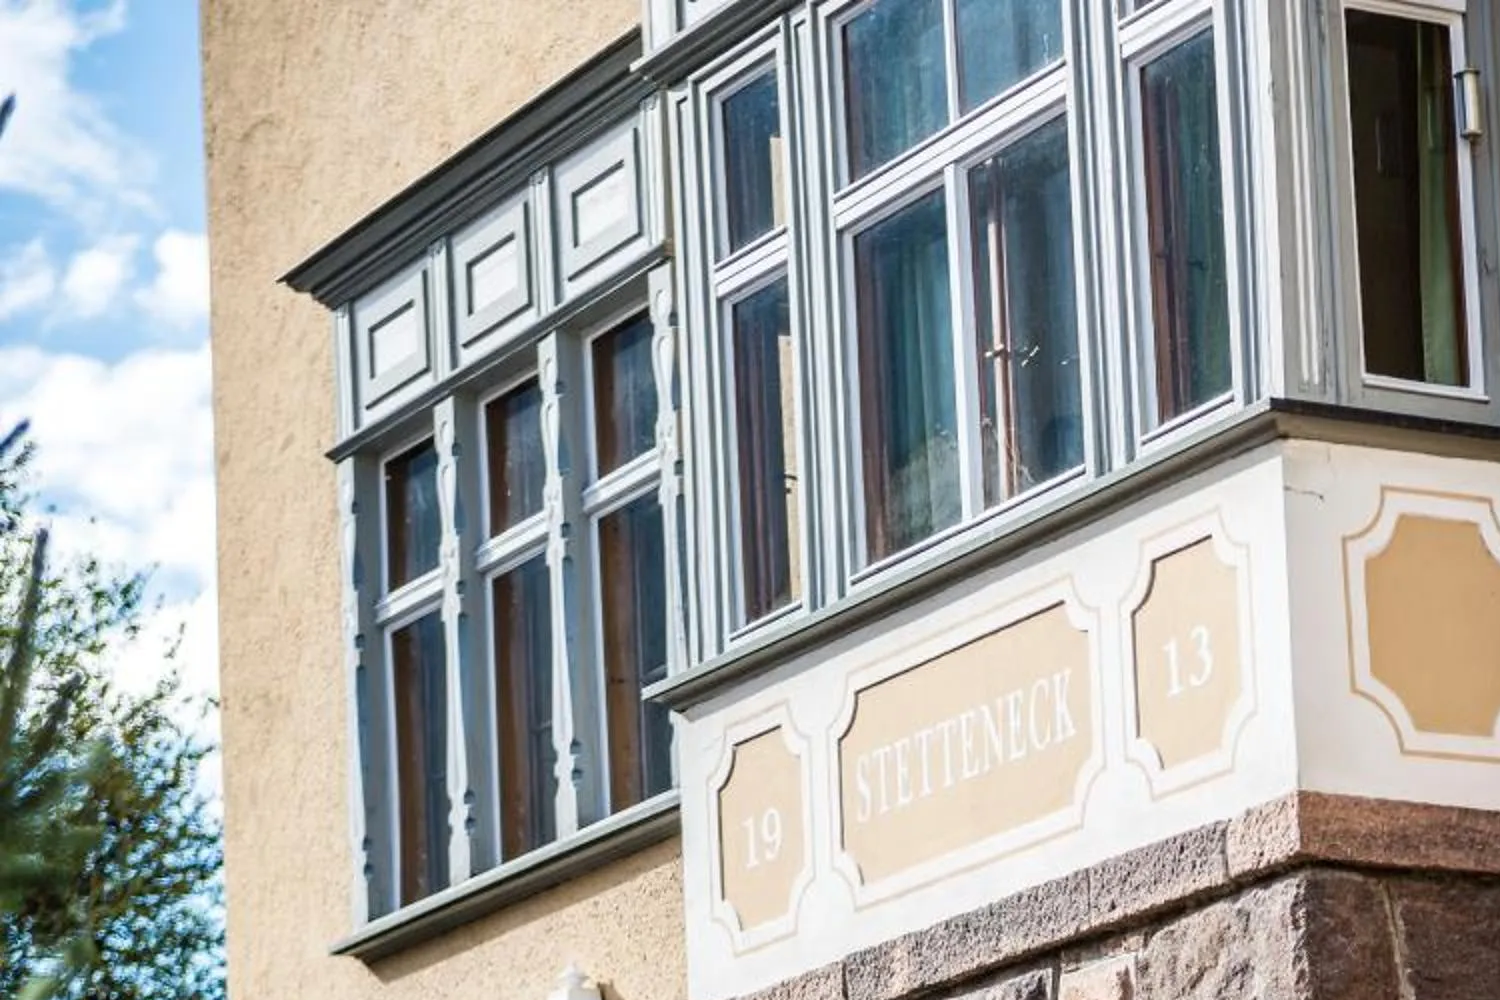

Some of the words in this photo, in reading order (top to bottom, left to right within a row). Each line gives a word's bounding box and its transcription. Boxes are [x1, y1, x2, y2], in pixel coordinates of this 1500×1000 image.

[1164, 626, 1213, 696] 13
[856, 669, 1076, 822] STETTENECK
[743, 809, 782, 869] 19
